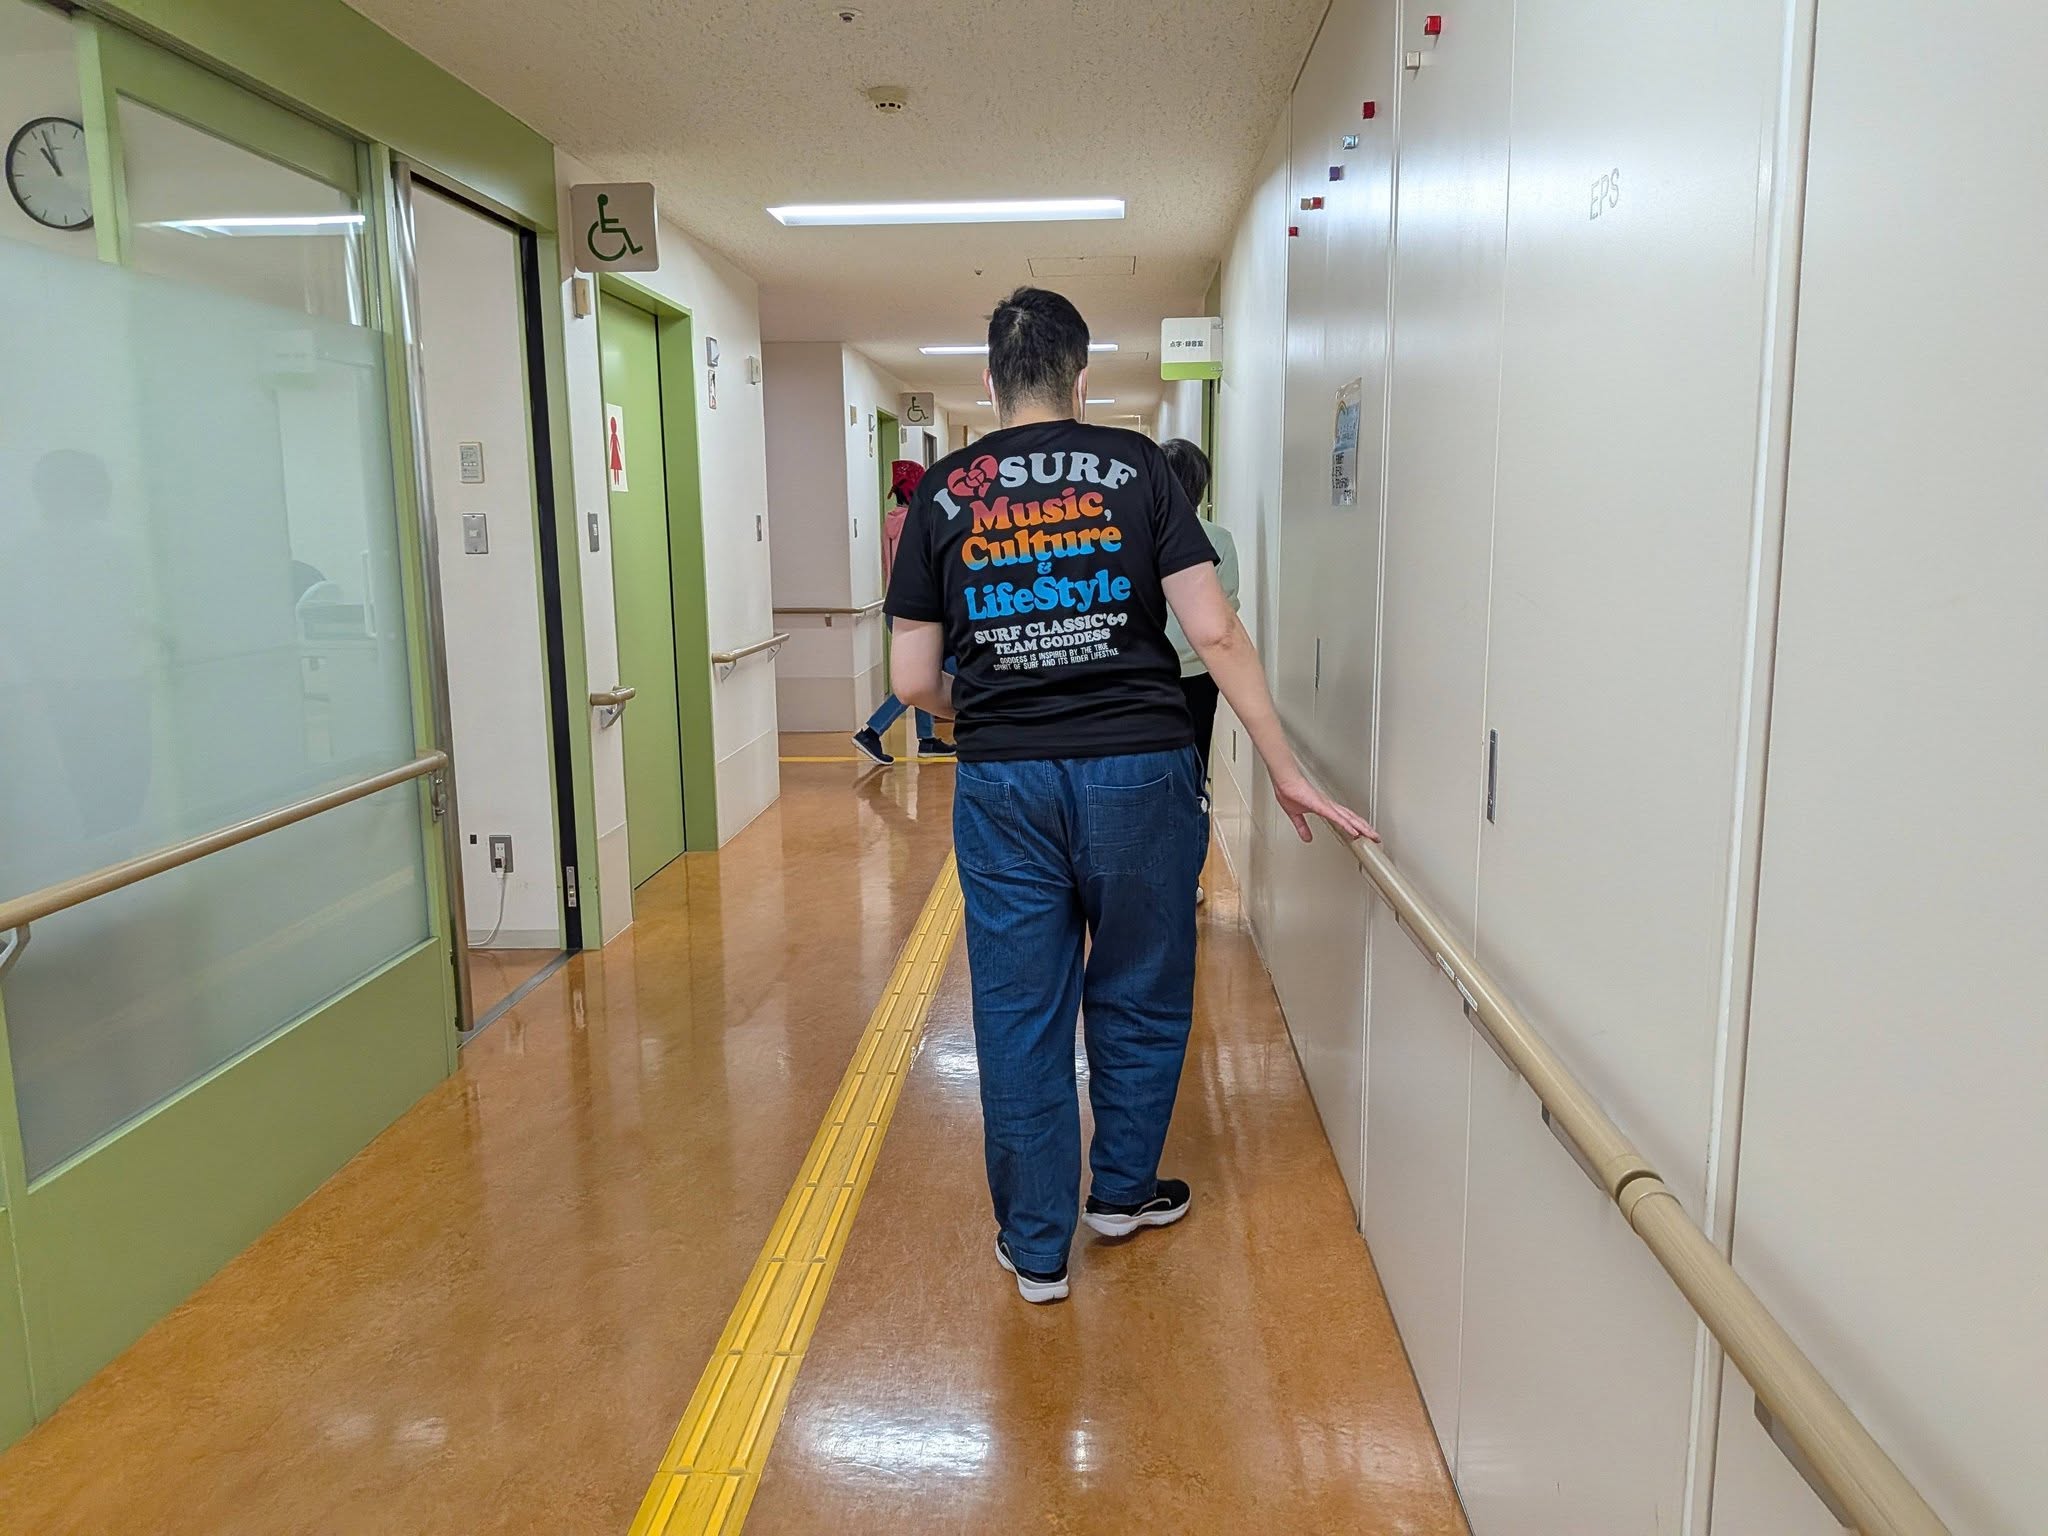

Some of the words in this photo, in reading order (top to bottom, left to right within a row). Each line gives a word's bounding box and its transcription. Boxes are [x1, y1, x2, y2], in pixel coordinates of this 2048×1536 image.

[1589, 167, 1620, 221] EPS
[933, 488, 961, 520] I
[998, 452, 1138, 490] SURF
[969, 487, 1112, 534] Music,
[961, 526, 1122, 571] Culture
[1037, 561, 1052, 574] &
[964, 569, 1131, 621] LifeStyle
[974, 624, 1022, 645] SURF
[994, 639, 1038, 655] TEAM
[1039, 628, 1111, 650] GODDESS
[993, 663, 1012, 671] SPIRIT
[1013, 662, 1021, 670] OF
[1023, 660, 1040, 670] SURF
[1042, 658, 1056, 667] AND
[1058, 656, 1069, 666] ITS
[1070, 654, 1089, 664] RIDER
[1091, 647, 1120, 661] LIFESTYLE
[999, 655, 1027, 664] GODDESS
[1029, 653, 1037, 661] IS
[1038, 649, 1067, 661] INSPIRED
[1069, 648, 1078, 656] BY
[1080, 646, 1092, 655] THE
[1094, 642, 1109, 652] TRUE
